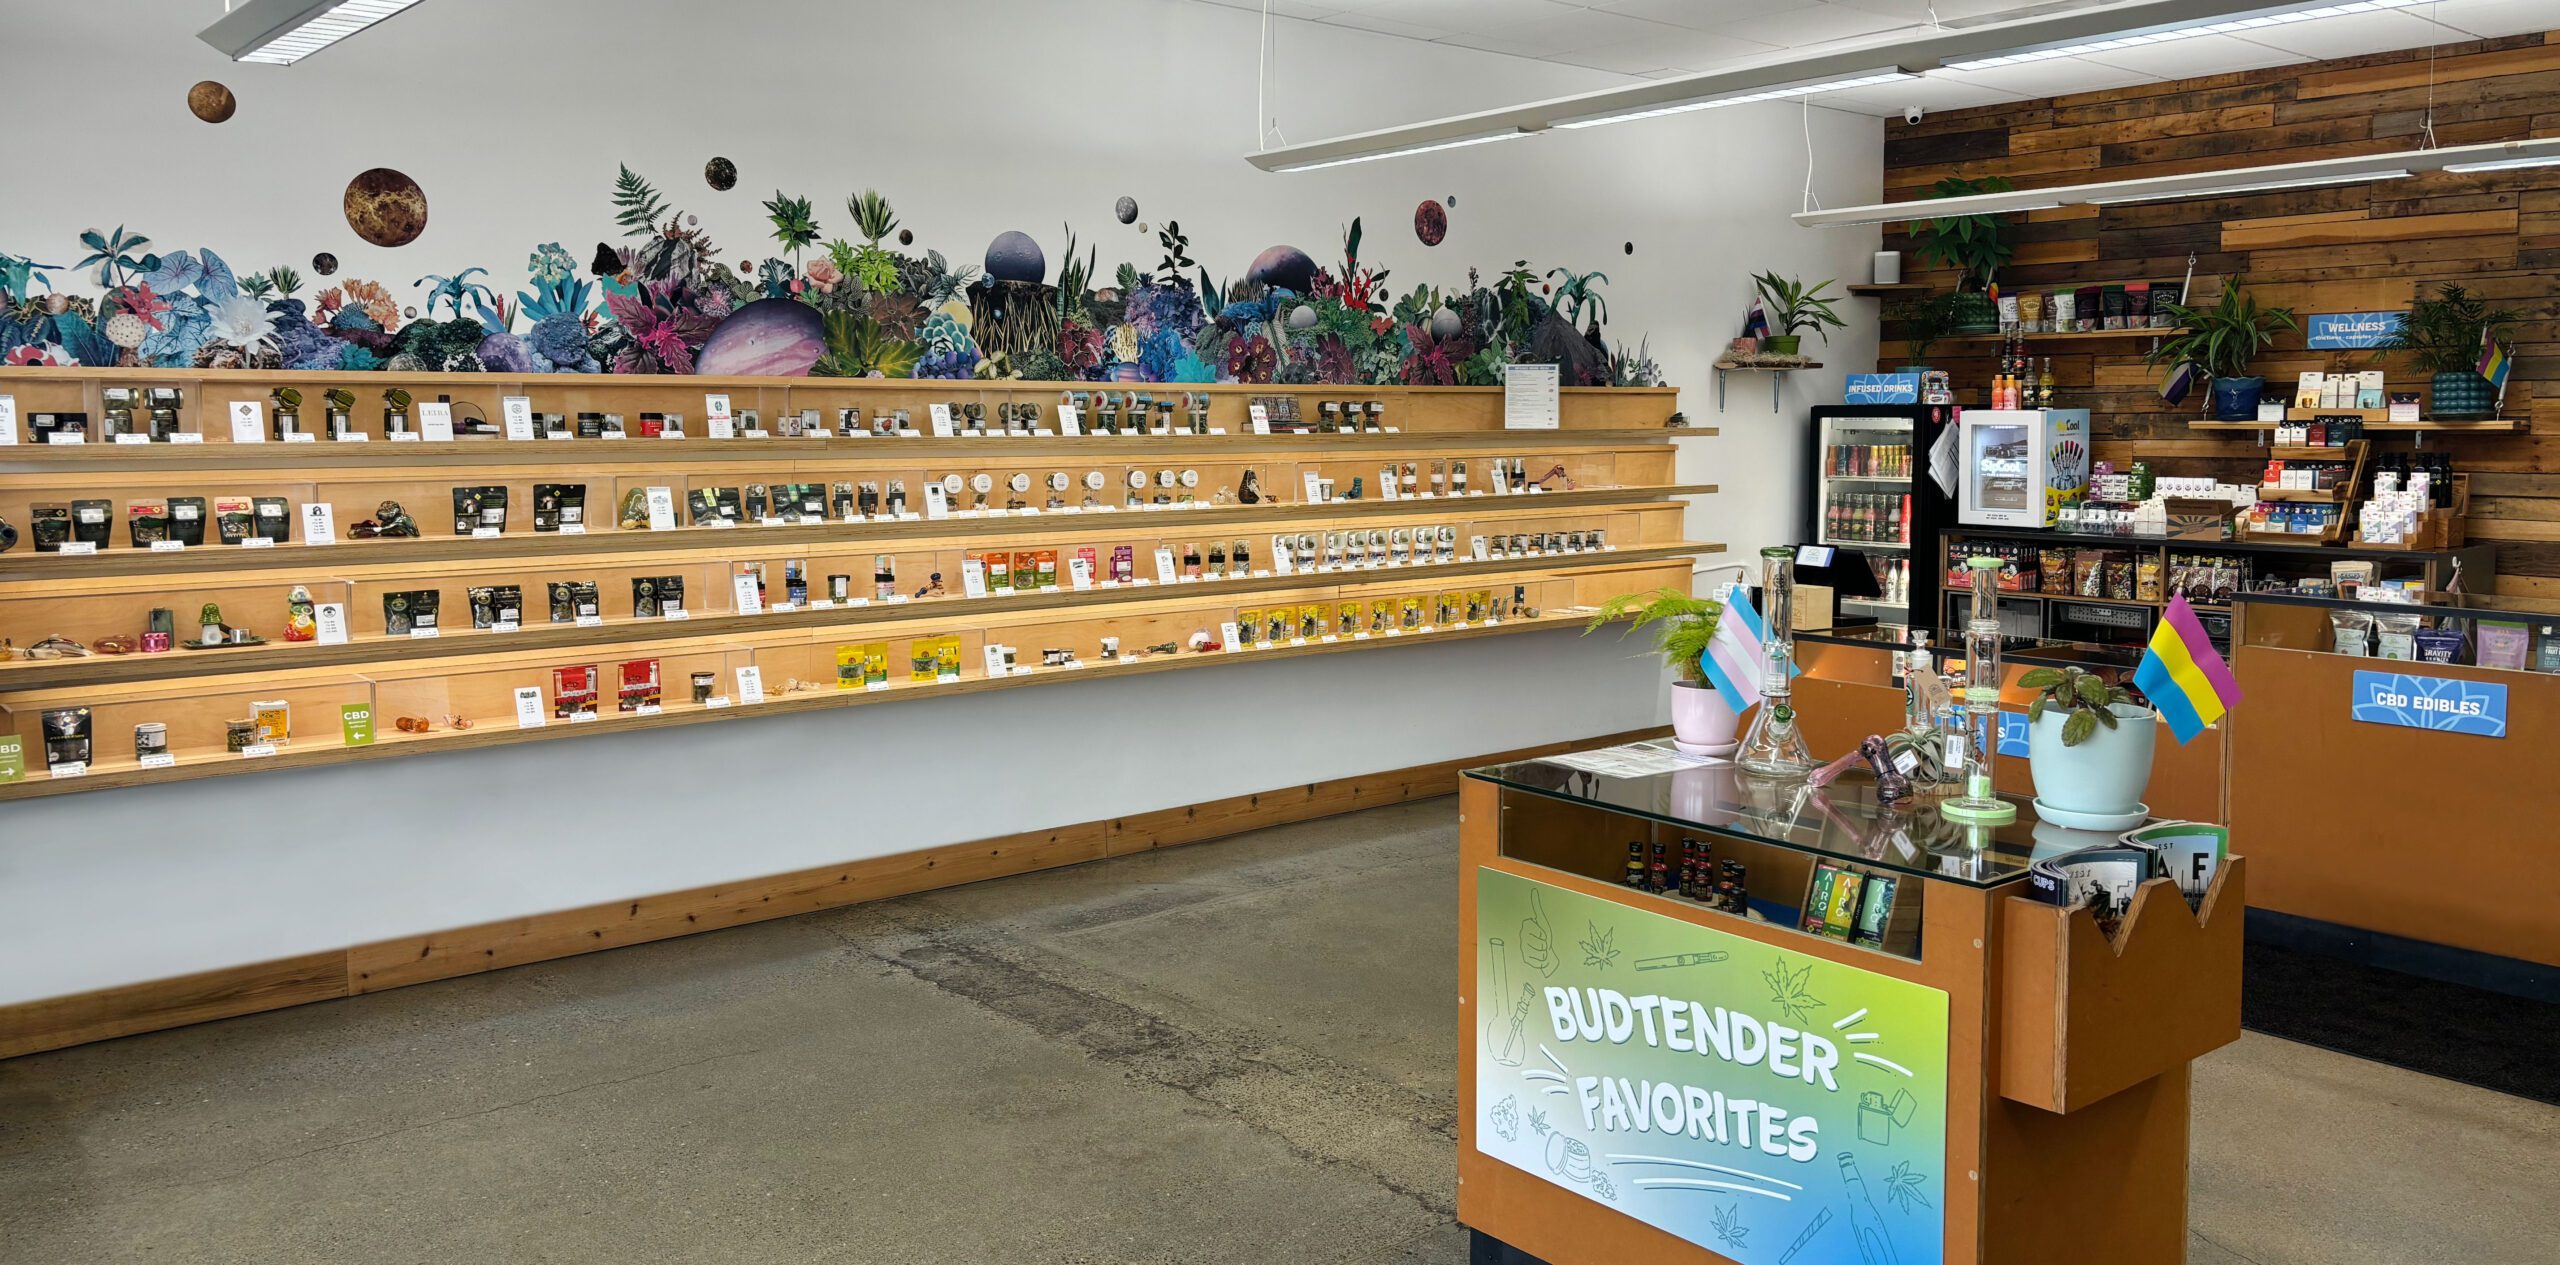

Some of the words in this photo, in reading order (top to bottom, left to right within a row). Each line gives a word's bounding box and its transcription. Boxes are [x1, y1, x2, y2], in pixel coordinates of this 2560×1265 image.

[2328, 322, 2386, 333] WELLNESS
[1848, 384, 1882, 393] INFUSED
[1883, 384, 1914, 393] DRINKS
[1980, 459, 2021, 474] SipCool
[2376, 692, 2407, 707] CBD
[2413, 696, 2481, 715] EDIBLES
[343, 711, 369, 720] CBD
[0, 743, 21, 754] BD
[2033, 873, 2055, 891] CUPS
[1544, 986, 1840, 1092] BUDTENDER
[1576, 1076, 1819, 1163] FAVORITES
